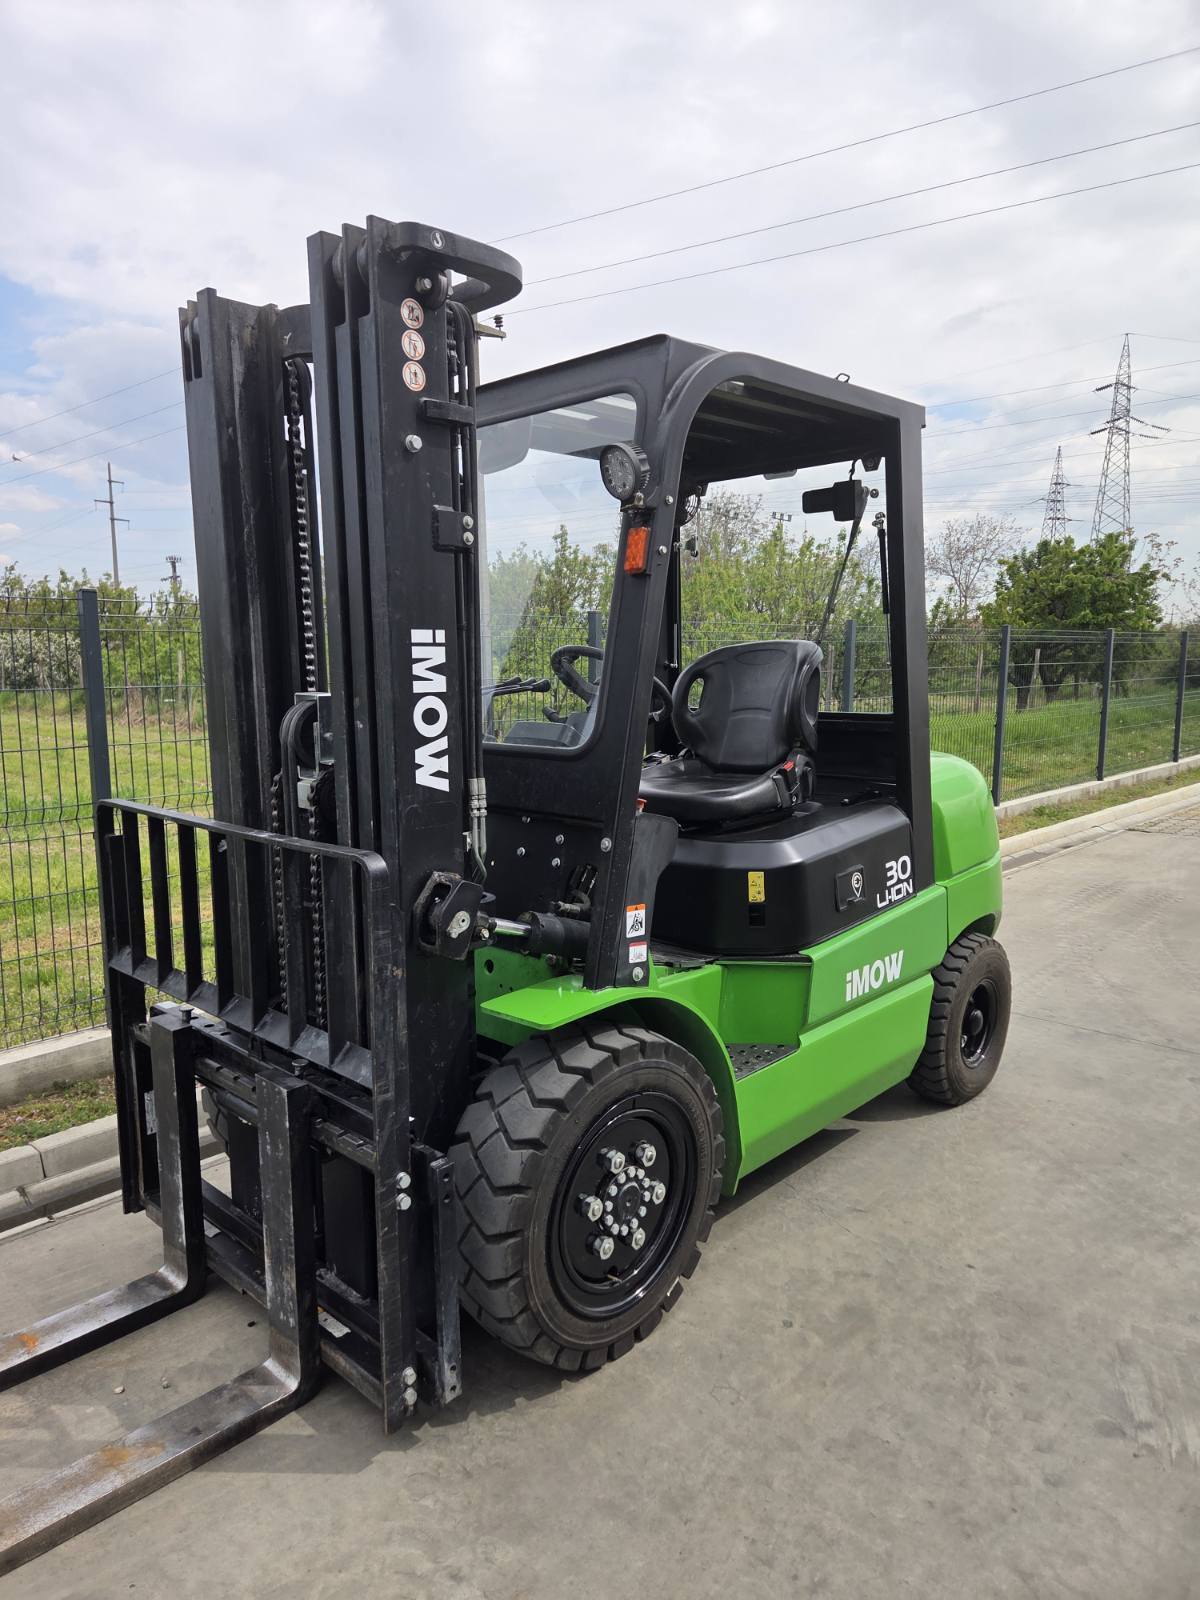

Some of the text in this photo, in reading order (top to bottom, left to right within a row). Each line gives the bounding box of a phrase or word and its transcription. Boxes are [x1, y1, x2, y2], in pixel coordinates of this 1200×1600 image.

[410, 628, 450, 792] iMOW
[885, 855, 911, 887] 30
[845, 950, 904, 1002] iMOW
